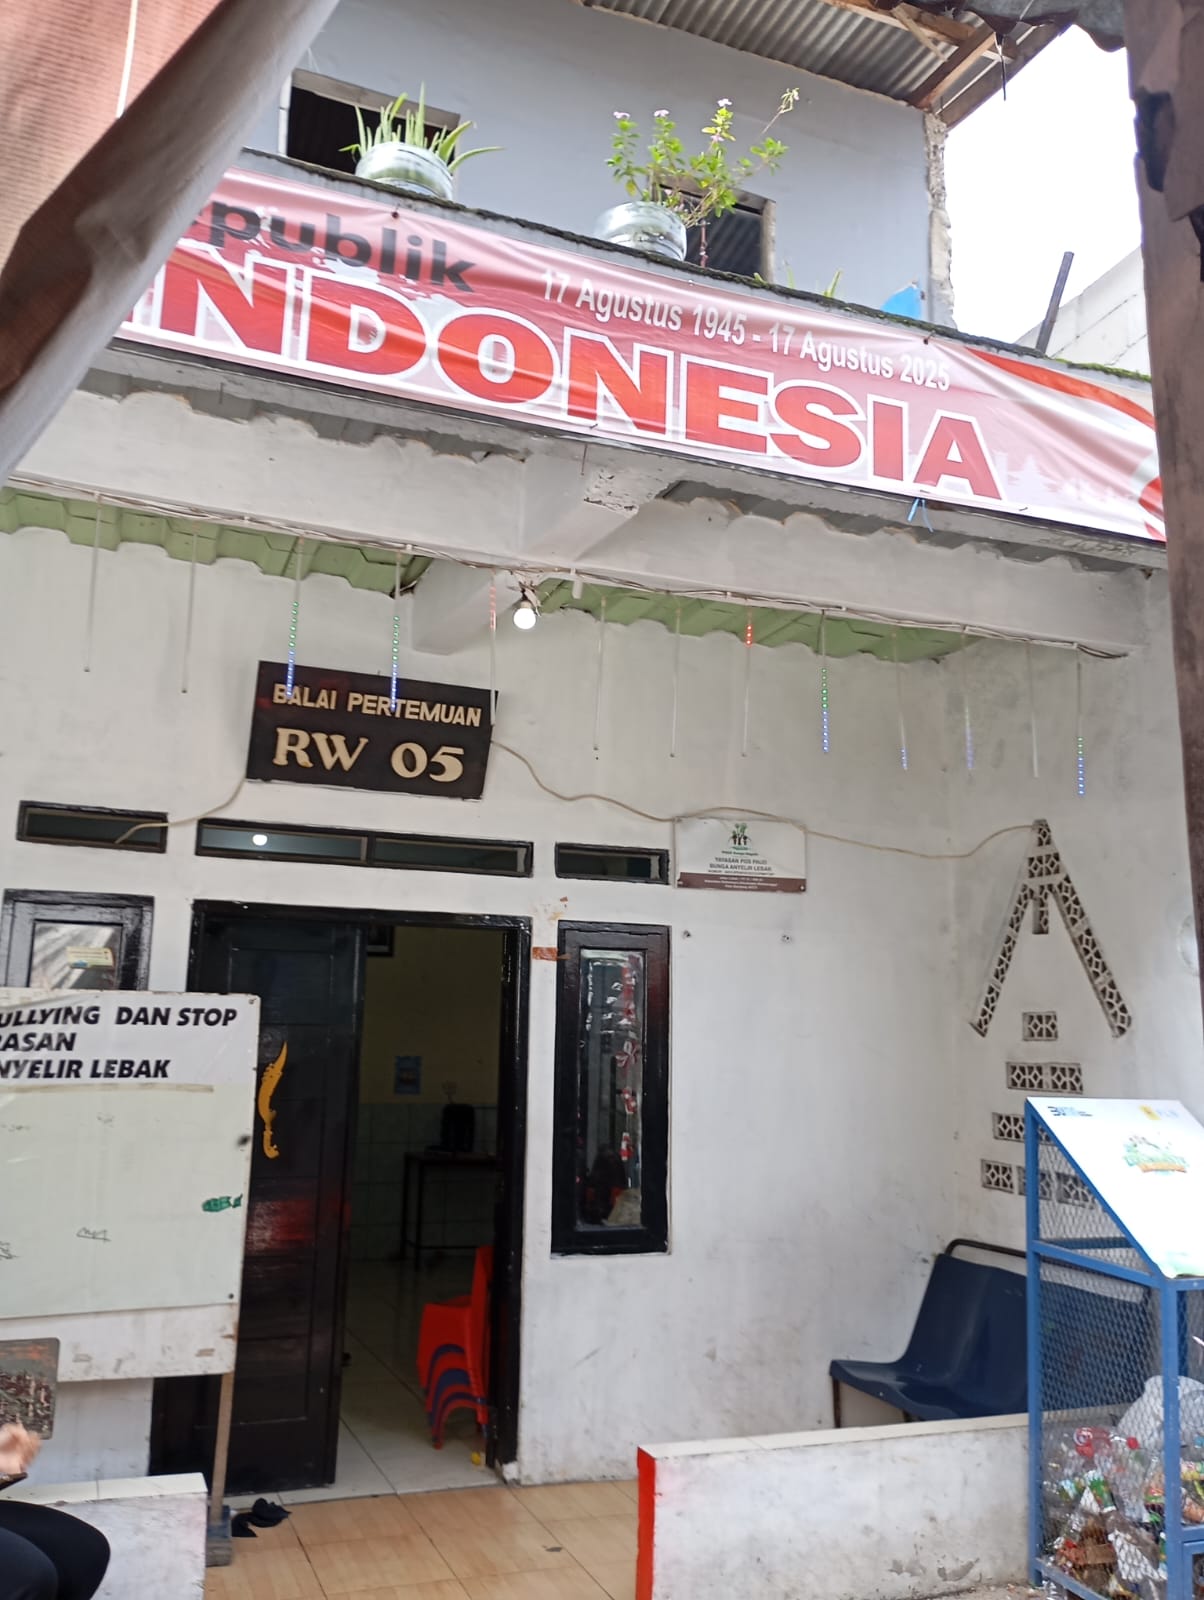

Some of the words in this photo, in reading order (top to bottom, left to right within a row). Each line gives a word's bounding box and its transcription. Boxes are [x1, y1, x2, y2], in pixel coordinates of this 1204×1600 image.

[193, 199, 476, 293] publik
[542, 269, 571, 304] 17
[576, 279, 683, 331] Agustus
[693, 303, 748, 345] 1945
[769, 322, 796, 356] 17
[800, 330, 894, 379] Agustus
[900, 354, 951, 391] 2025
[126, 240, 1004, 502] NDONESIA
[272, 683, 337, 709] BALAI
[347, 692, 482, 727] PERTEMUAN
[272, 727, 369, 772] RW
[391, 742, 465, 783] 05
[115, 1007, 171, 1026] DAN
[176, 1007, 238, 1027] STOP
[89, 1059, 170, 1079] LEBAK
